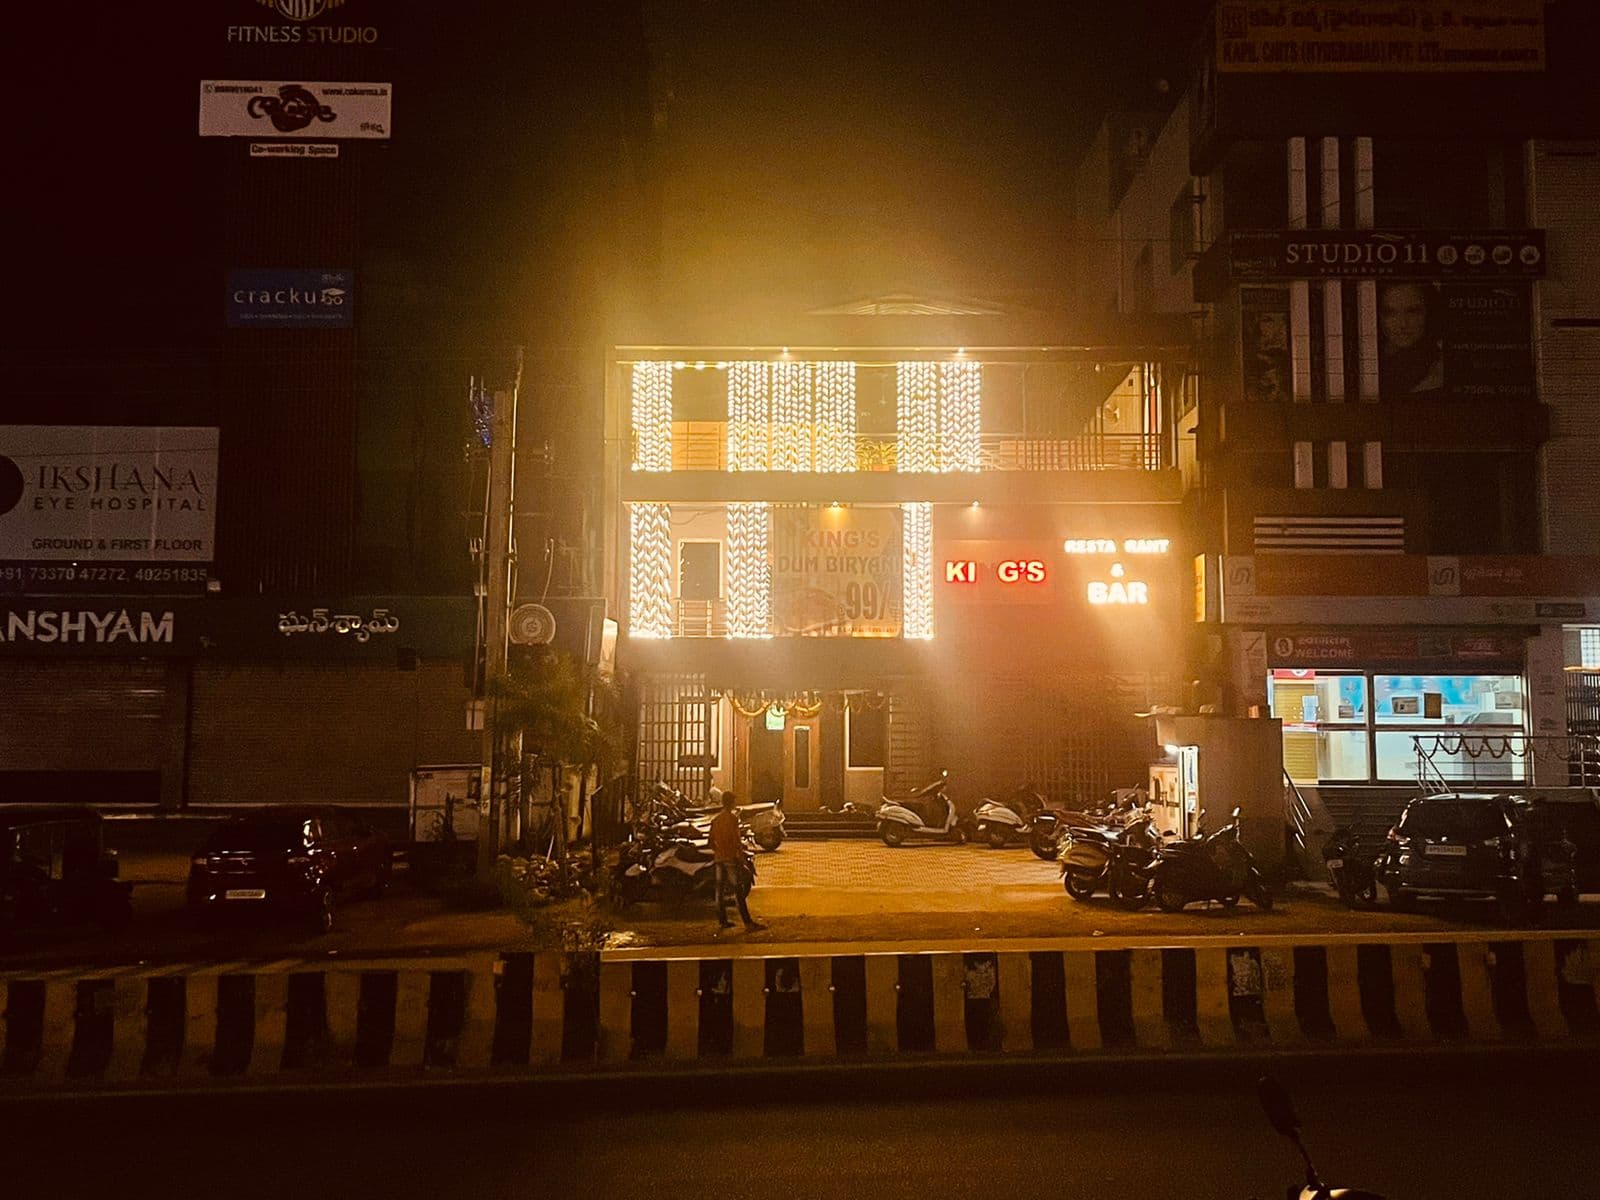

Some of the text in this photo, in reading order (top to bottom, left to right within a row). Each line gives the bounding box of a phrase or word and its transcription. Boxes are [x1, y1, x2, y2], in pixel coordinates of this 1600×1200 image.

[227, 26, 378, 43] FITNESS STUDIO
[251, 144, 337, 156] Co-working Space
[1286, 243, 1428, 264] STUDIO 11
[38, 463, 203, 495] IKSHANA
[34, 497, 207, 511] EYE HOSPITAL
[32, 538, 203, 550] GROUND & FIRST FLOOR
[803, 530, 880, 549] KING'S
[30, 567, 75, 581] 73370
[135, 568, 207, 581] 40251835
[778, 556, 900, 575] DUM BIRYANI
[1086, 581, 1148, 605] BAR
[0, 608, 175, 643] NSHYAM
[1295, 649, 1354, 659] WELCOME
